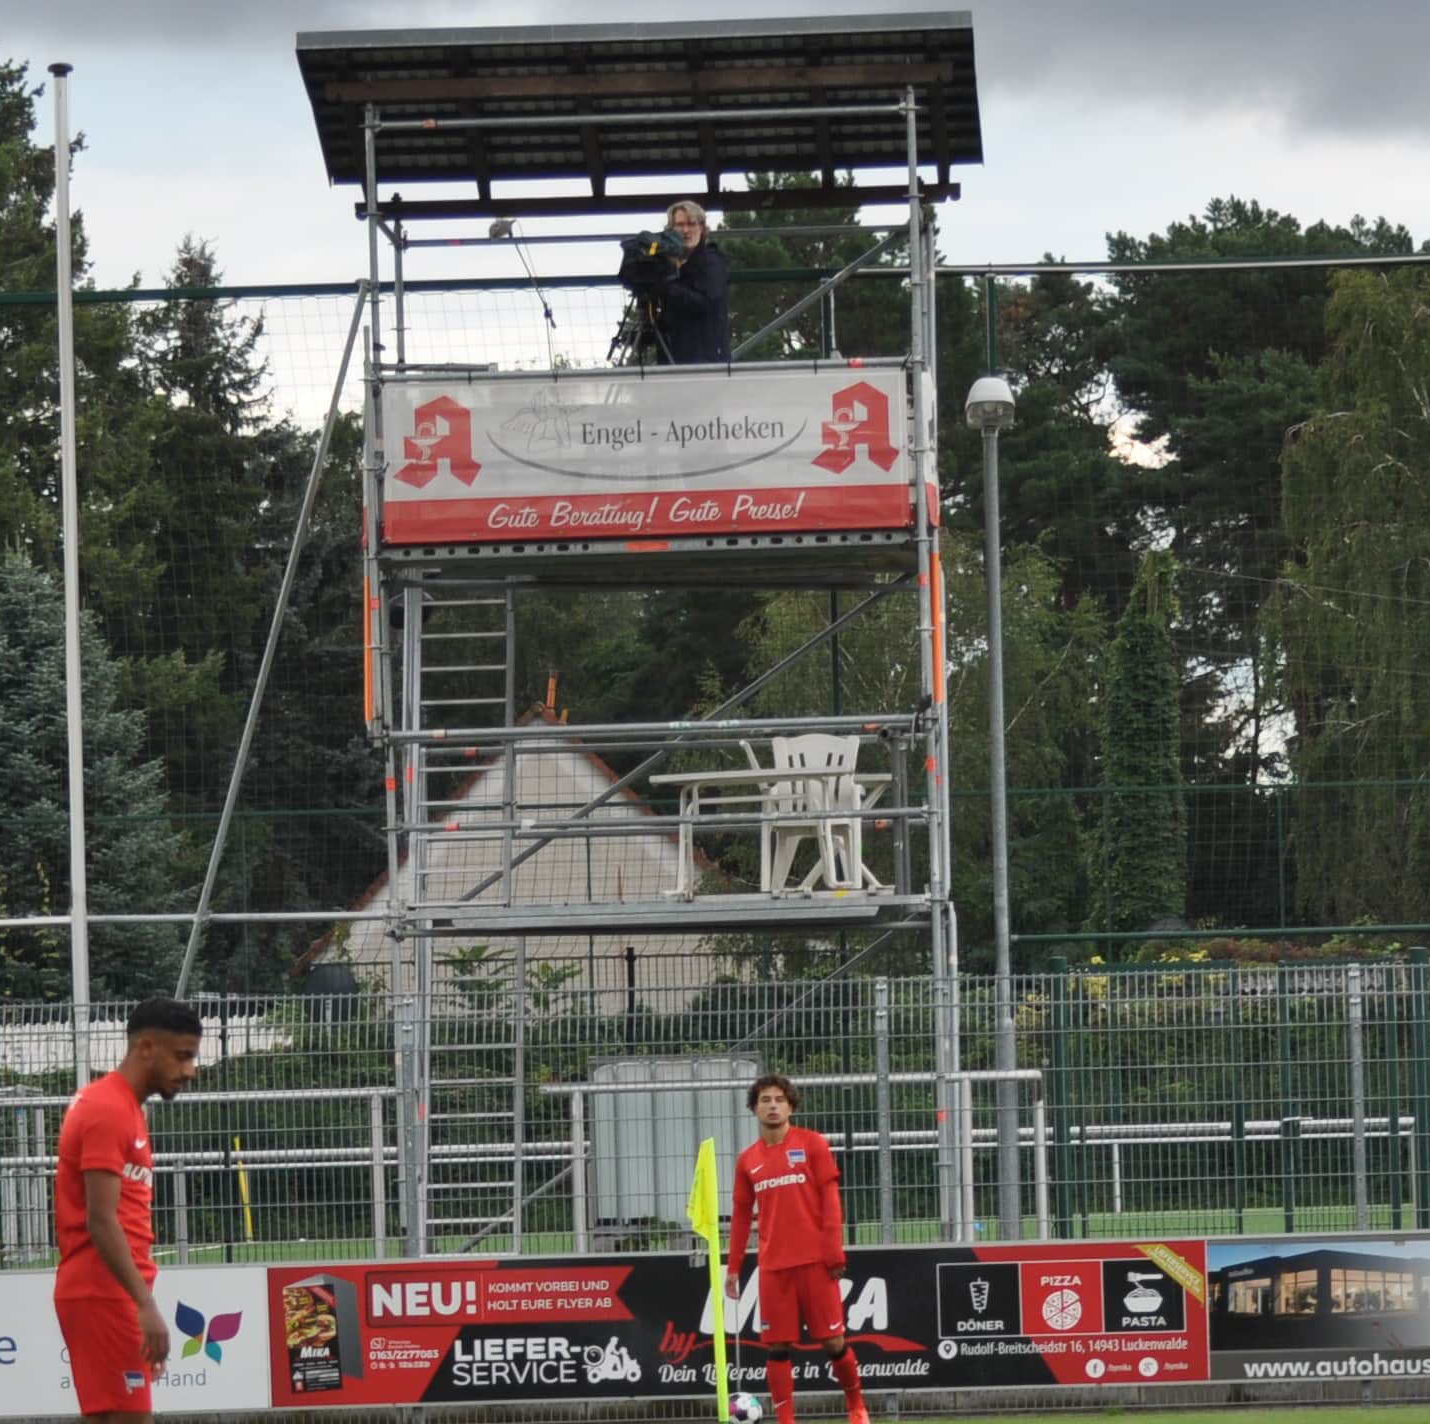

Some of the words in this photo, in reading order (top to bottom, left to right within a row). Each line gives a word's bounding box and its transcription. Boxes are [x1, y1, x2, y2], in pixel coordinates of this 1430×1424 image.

[582, 419, 642, 449] Engel
[666, 416, 785, 448] Apotheken
[487, 504, 539, 529] Gute
[550, 496, 659, 532] Beratung!
[669, 496, 721, 523] Gute
[732, 491, 805, 521] Preise!
[488, 1282, 534, 1294] KOMMT
[535, 1281, 579, 1293] VORBEI
[582, 1280, 609, 1291] UND
[1040, 1275, 1082, 1287] PIZZA
[372, 1281, 477, 1318] NEU!
[487, 1300, 518, 1311] HOLT
[521, 1299, 552, 1310] EURE
[557, 1298, 593, 1309] FLYER
[595, 1297, 612, 1308] AB
[957, 1318, 1005, 1332] DÖNER
[1122, 1316, 1167, 1328] PASTA
[454, 1337, 581, 1362] LIEFER-
[658, 1321, 698, 1365] by
[1088, 1339, 1120, 1352] 14943
[1121, 1337, 1188, 1351] Luckenwalde
[452, 1360, 577, 1386] SERVICE
[658, 1364, 697, 1384] Dein
[803, 1360, 820, 1379] in
